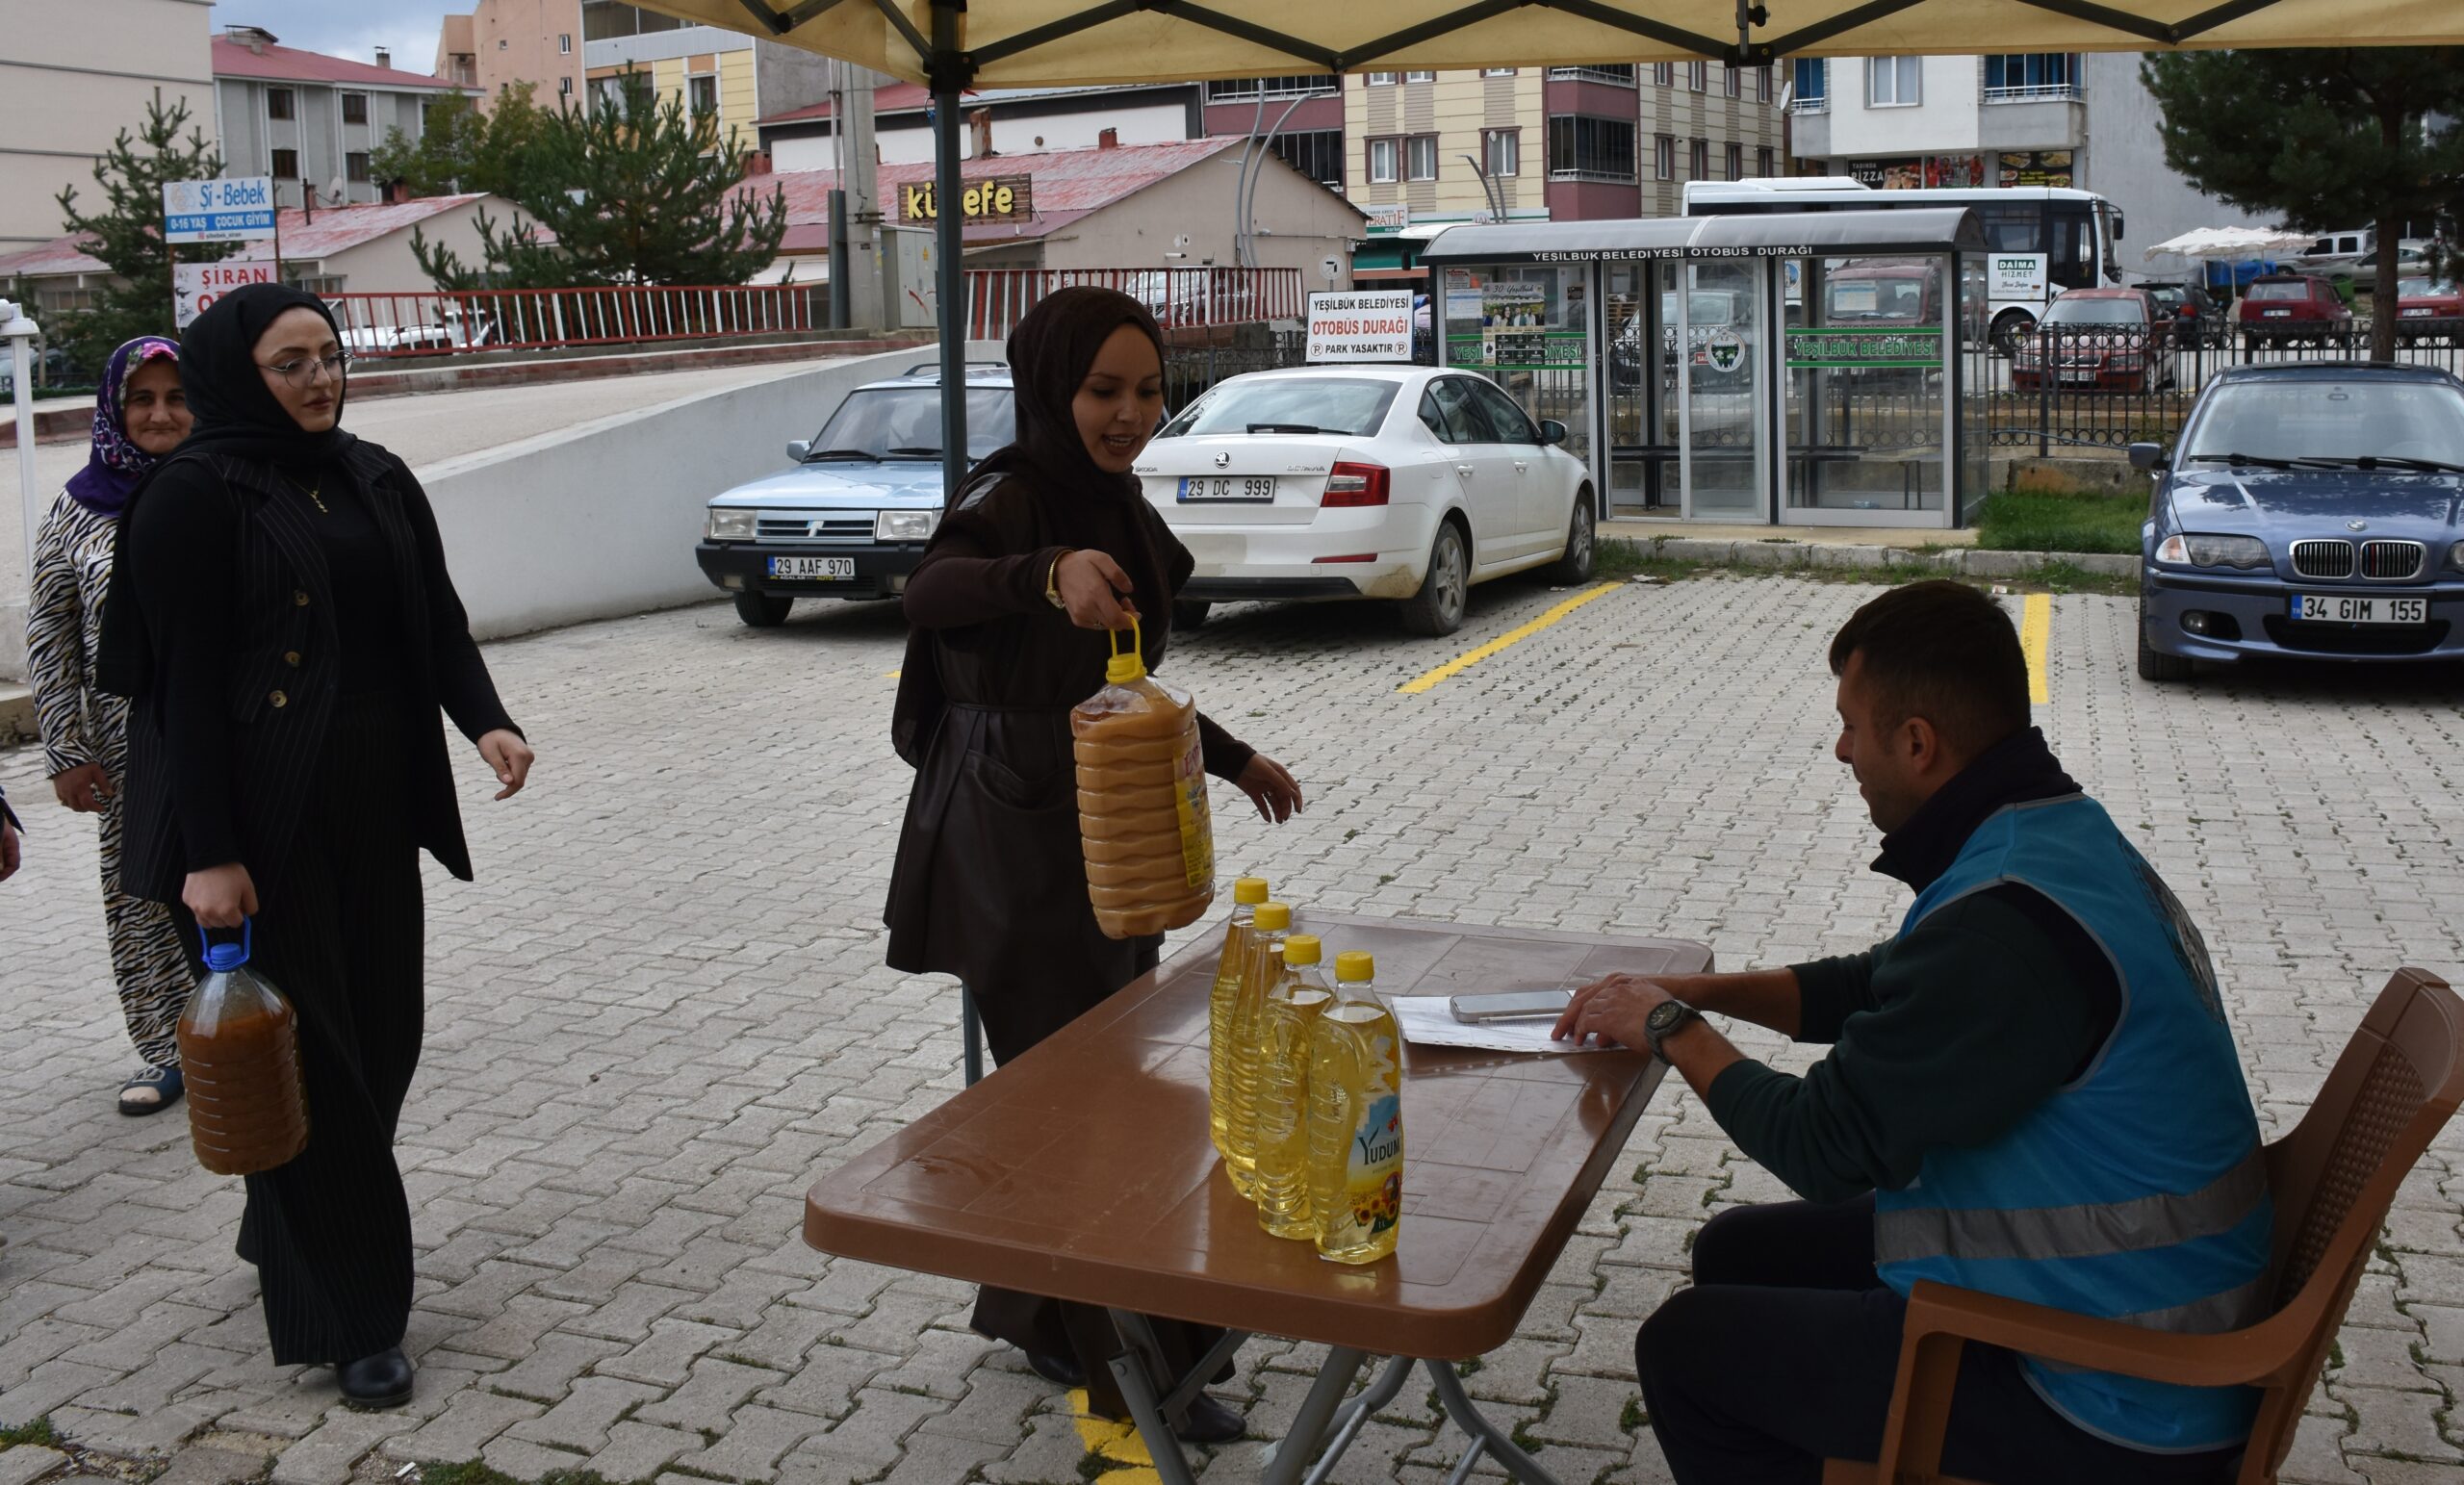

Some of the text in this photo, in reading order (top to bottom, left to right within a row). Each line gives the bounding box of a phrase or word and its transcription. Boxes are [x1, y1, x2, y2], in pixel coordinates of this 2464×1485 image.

[200, 183, 212, 211] Şi
[223, 180, 266, 206] Bebek
[908, 181, 1014, 218] küefe
[170, 211, 270, 230] 0-16 YAŞ ÇOCUK GİYİM
[1690, 245, 1750, 257] OTOBÜS
[1757, 244, 1812, 256] DURAĞI
[1999, 260, 2035, 269] DAİMA
[2001, 269, 2033, 278] HİZMET
[202, 265, 268, 290] ŞİRAN
[1314, 294, 1409, 313] YEŞİLBÜK BELEDİYESİ
[1312, 316, 1408, 336] OTOBÜS DURAĞI
[1325, 345, 1348, 354] PARK
[1350, 344, 1393, 354] YASAKTIR
[1188, 480, 1204, 497] 29
[1213, 480, 1231, 496] DC
[1245, 479, 1270, 496] 999
[777, 558, 852, 575] 29 AAF 970
[2304, 598, 2327, 618] 34
[2339, 599, 2373, 621] GIM
[2389, 600, 2423, 621] 155
